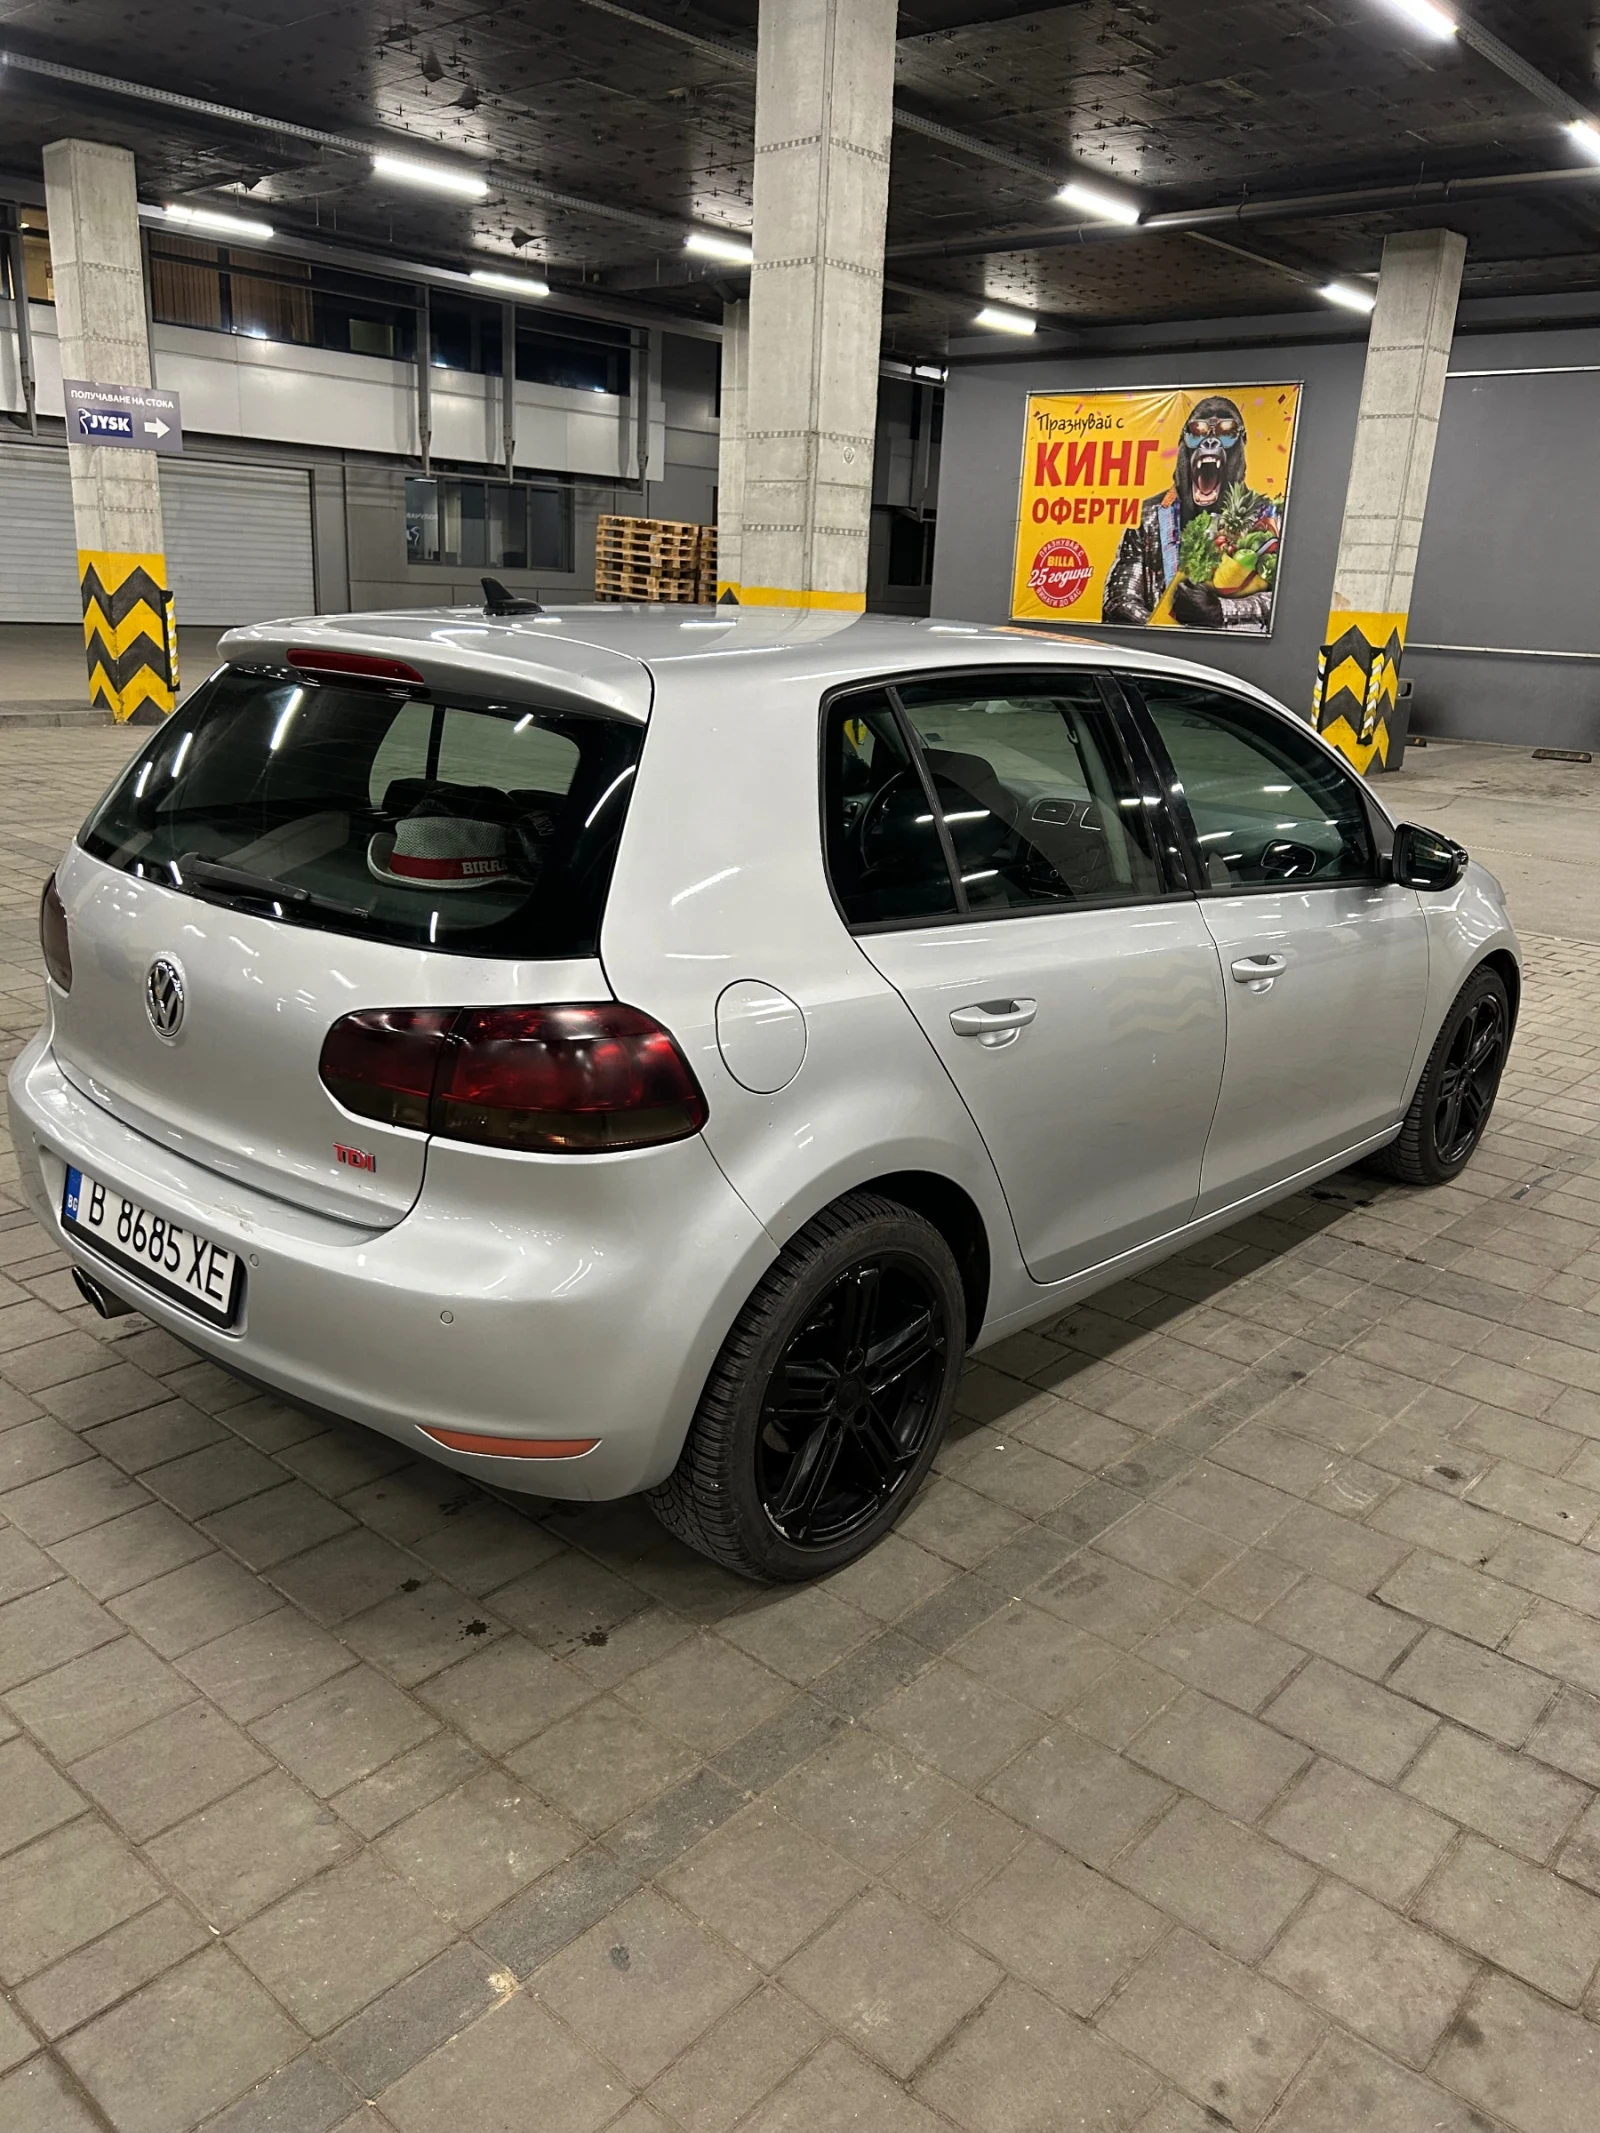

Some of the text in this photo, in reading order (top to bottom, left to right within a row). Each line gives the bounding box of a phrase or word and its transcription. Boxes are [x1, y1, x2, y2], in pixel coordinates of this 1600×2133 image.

[71, 389, 174, 409] ПОЛУЧАВАНЕ НА СТОКА
[90, 415, 130, 432] JYSK
[1037, 413, 1124, 440] Празнувай с
[1034, 440, 1159, 487] КИНГ
[1032, 497, 1140, 525] ОФЕРТИ
[1047, 556, 1075, 567] BILLA
[1027, 567, 1093, 588] 25 години
[333, 1142, 376, 1173] TDI
[67, 1194, 79, 1212] BG
[89, 1181, 228, 1302] B 8685 XE
